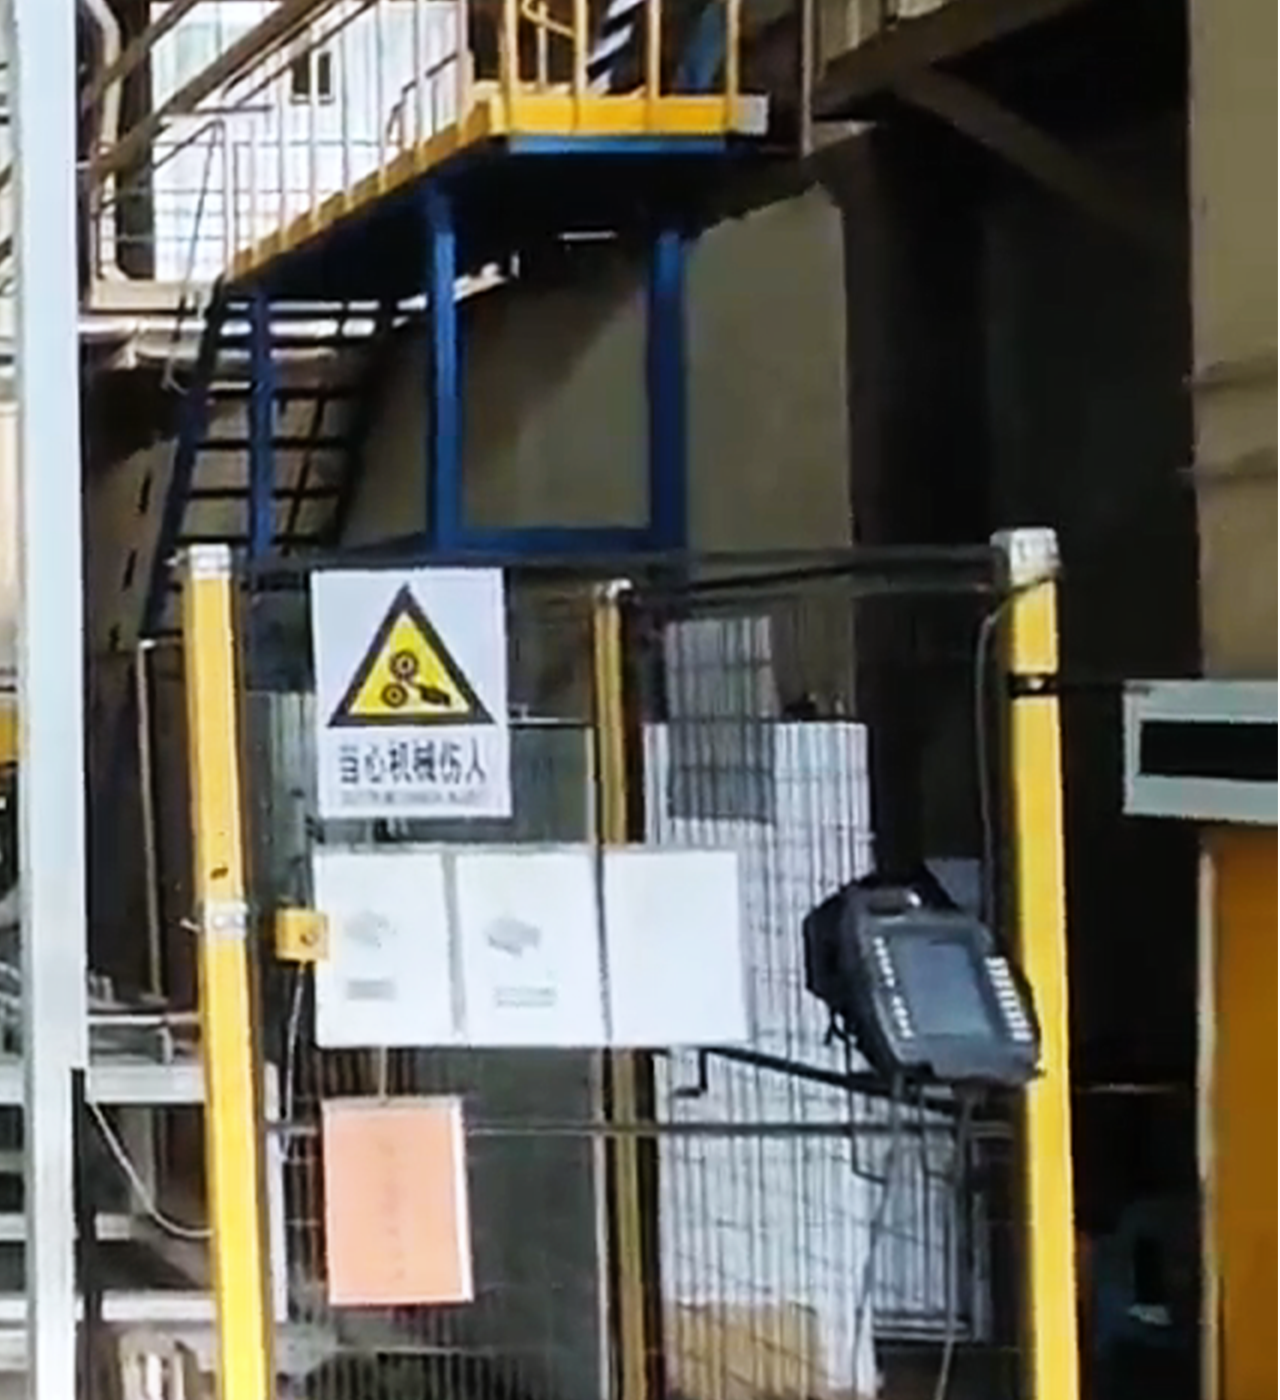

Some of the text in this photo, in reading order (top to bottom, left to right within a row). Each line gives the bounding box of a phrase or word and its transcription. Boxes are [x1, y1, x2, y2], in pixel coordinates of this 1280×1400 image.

[338, 737, 487, 785] 当心机械伤人
